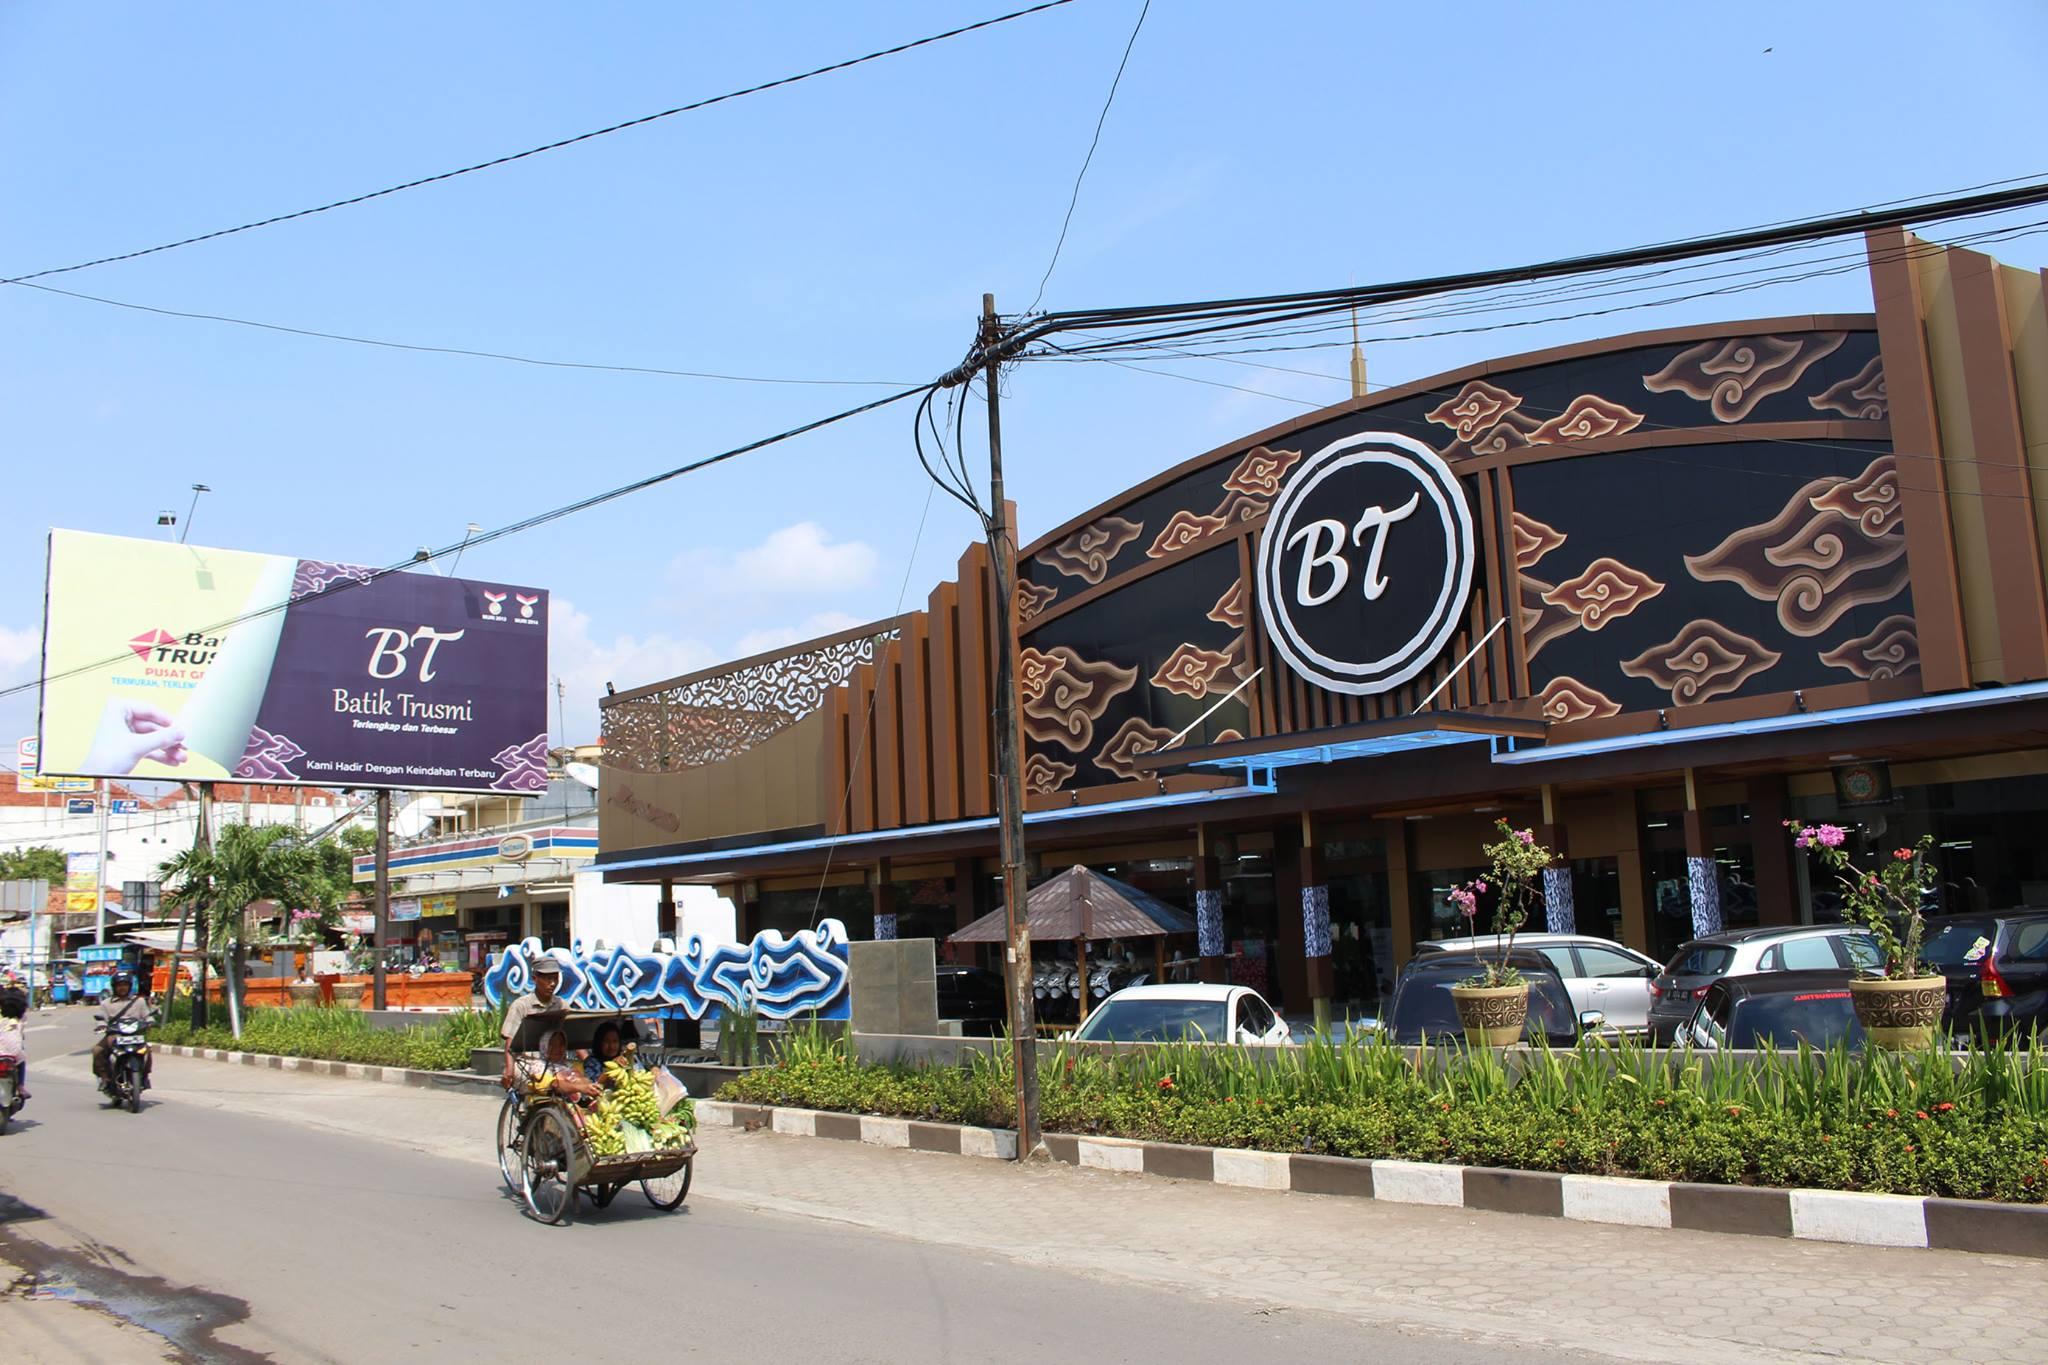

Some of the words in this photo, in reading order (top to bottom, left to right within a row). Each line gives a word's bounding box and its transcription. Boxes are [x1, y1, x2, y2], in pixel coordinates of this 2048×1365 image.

[1287, 491, 1419, 607] BT
[365, 626, 465, 683] BT
[145, 667, 186, 679] PUSAT
[332, 688, 393, 716] Batik
[397, 693, 473, 721] Trusmi
[352, 719, 400, 732] Terlengkap
[402, 723, 419, 732] dan
[421, 724, 458, 735] Terbesar
[306, 760, 333, 770] Kami
[335, 761, 363, 772] Hadir
[365, 763, 404, 775] Dengan
[406, 765, 456, 777] Keindahan
[459, 768, 496, 779] Terbaru
